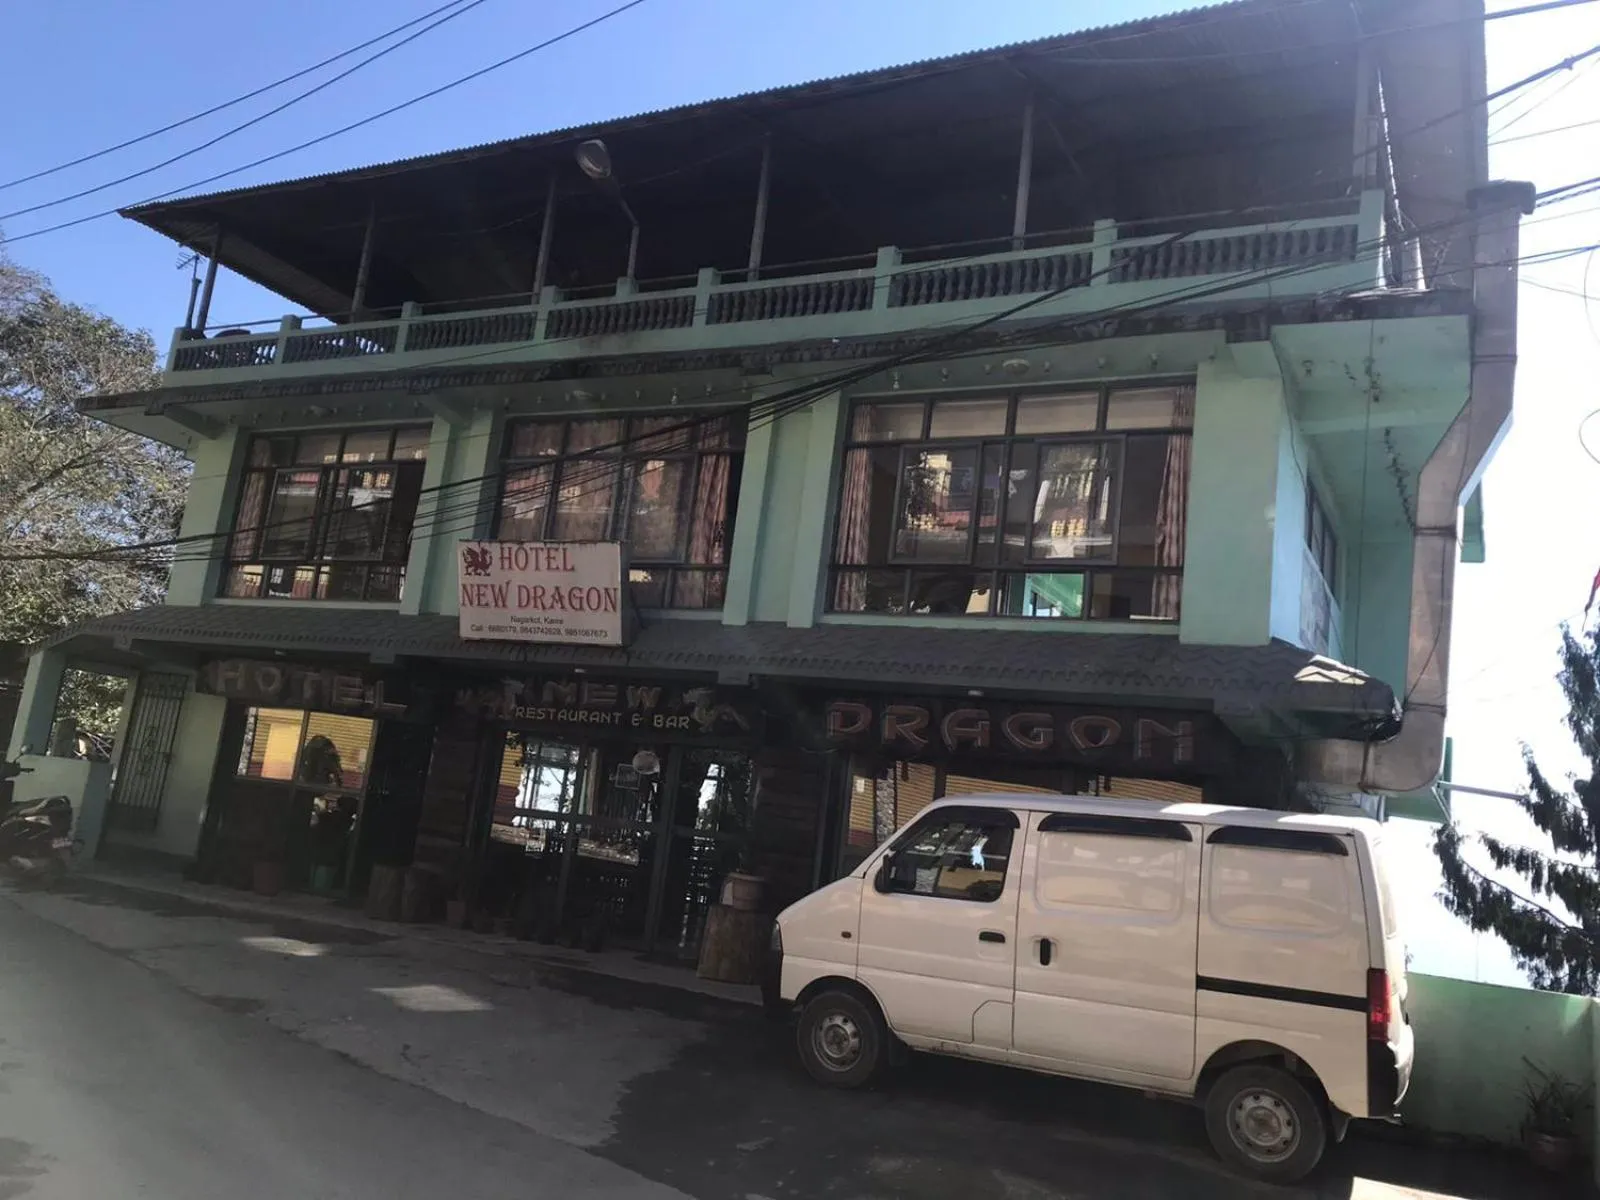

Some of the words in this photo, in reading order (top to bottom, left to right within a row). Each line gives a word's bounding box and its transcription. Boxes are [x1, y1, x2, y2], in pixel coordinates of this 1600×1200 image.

[499, 546, 575, 573] HOTEL
[461, 580, 512, 608] NEW
[518, 584, 618, 613] DRAGON
[216, 662, 408, 712] HOTEL
[542, 680, 663, 710] NEW
[826, 701, 1195, 765] DRAGON
[514, 706, 622, 726] RESTAURANT
[653, 713, 691, 730] BAR
